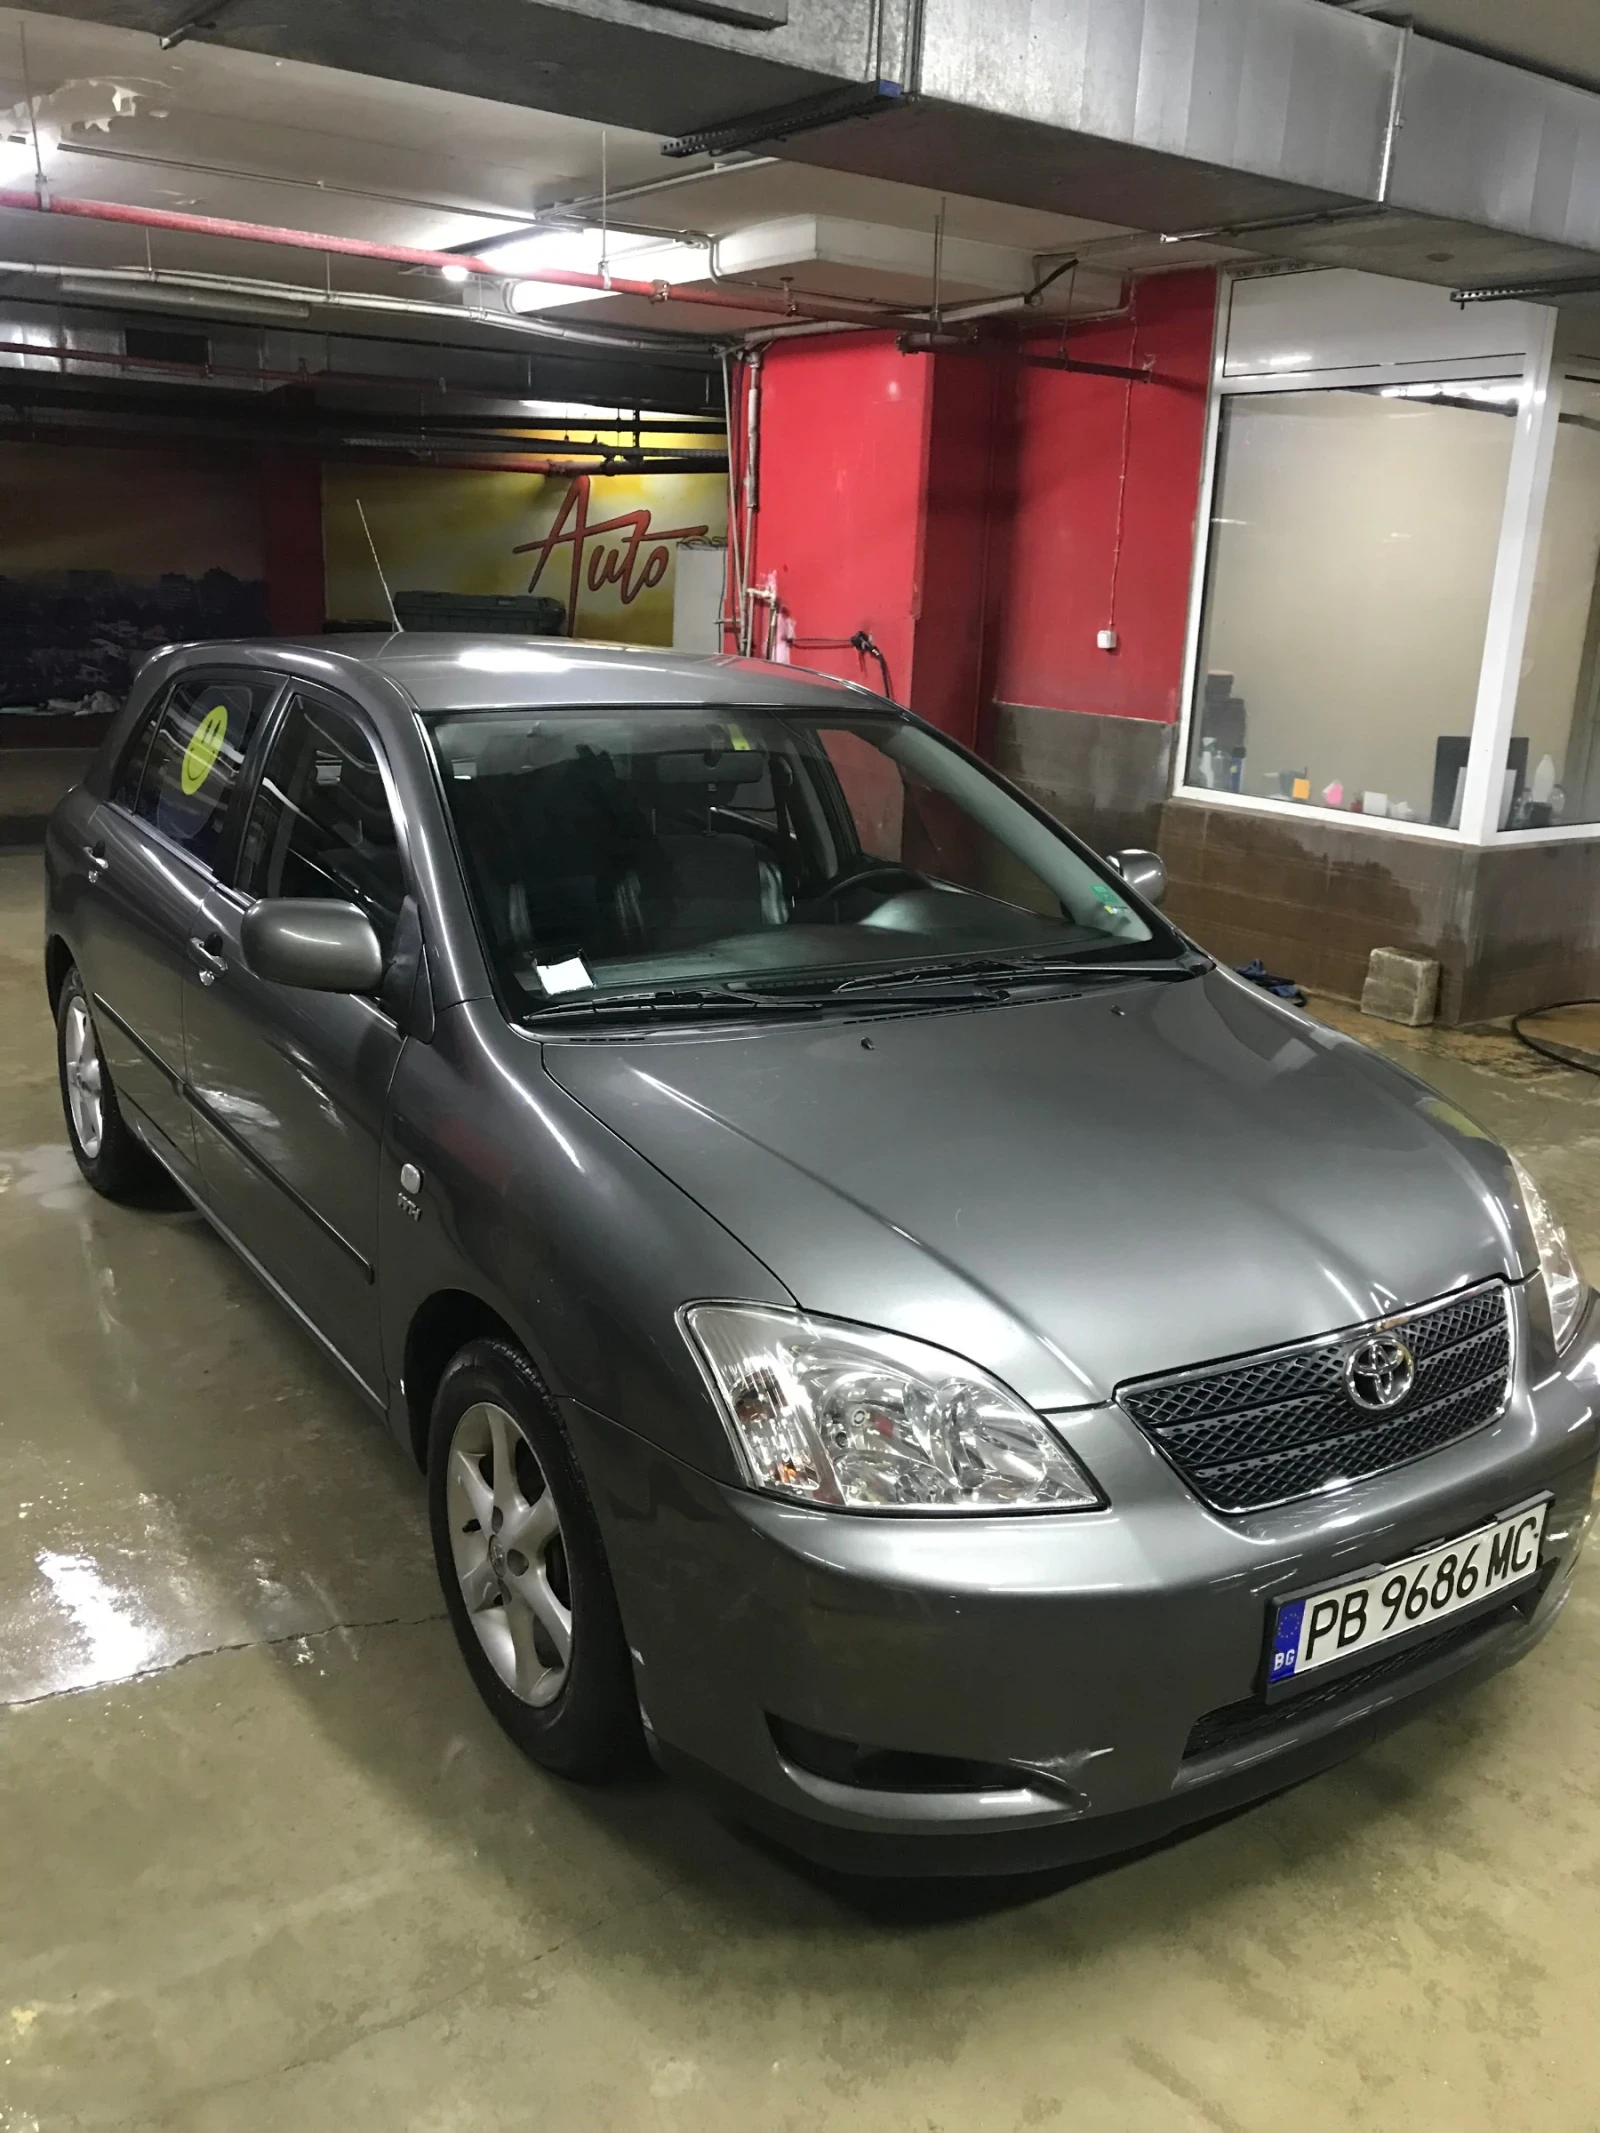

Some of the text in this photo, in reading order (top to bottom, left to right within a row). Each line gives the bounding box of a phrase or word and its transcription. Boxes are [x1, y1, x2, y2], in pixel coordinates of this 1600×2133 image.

[512, 474, 709, 637] Auto
[1273, 1648, 1296, 1671] BG
[1305, 1516, 1538, 1662] PB 9686 MC
